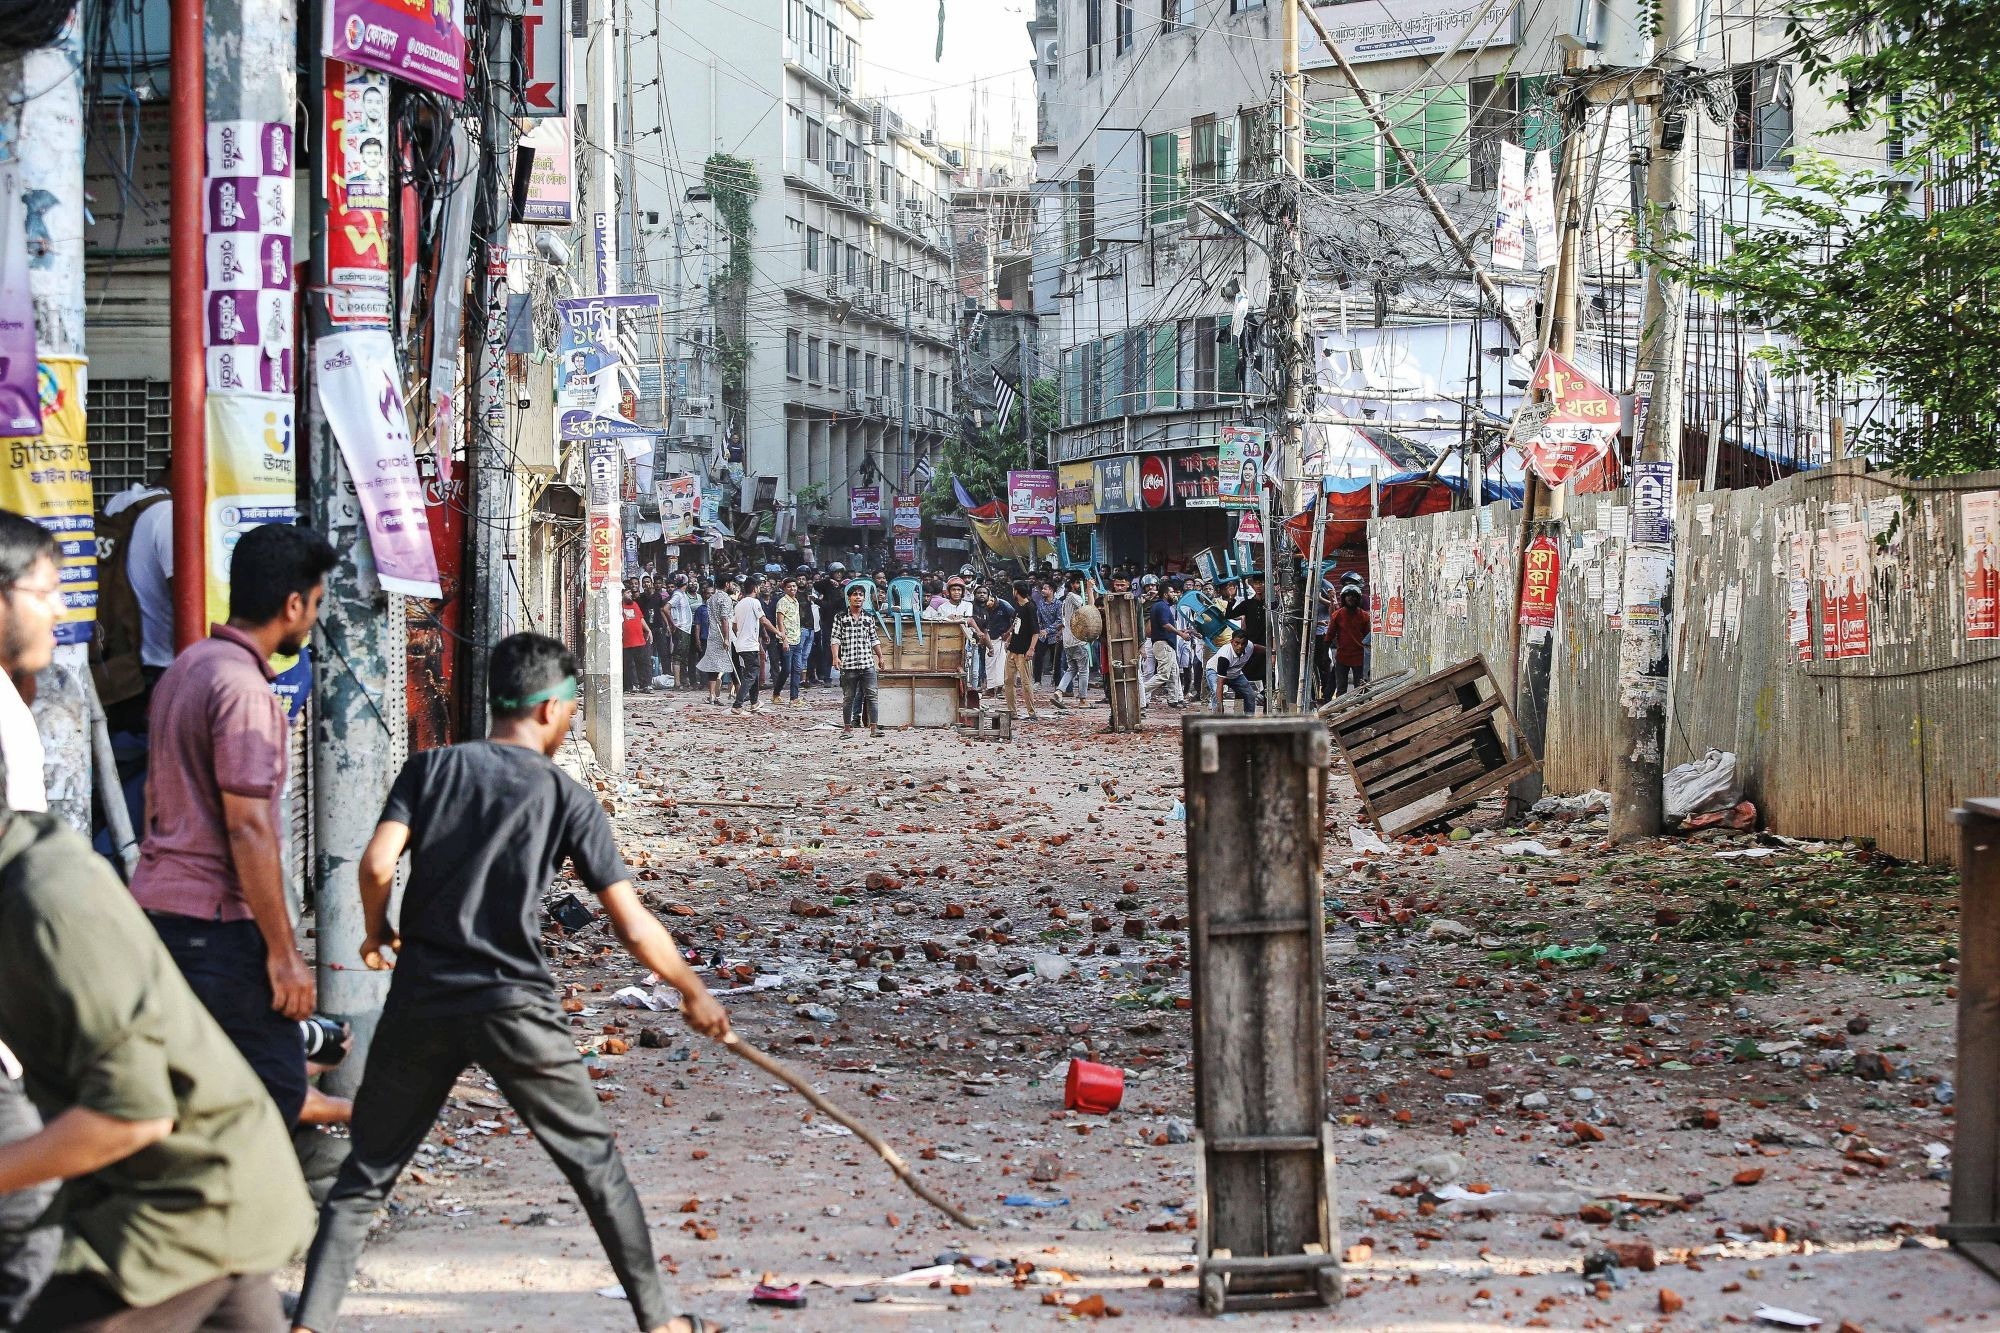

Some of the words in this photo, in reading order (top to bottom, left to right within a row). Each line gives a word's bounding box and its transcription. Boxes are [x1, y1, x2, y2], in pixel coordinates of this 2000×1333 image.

[1565, 400, 1608, 418] খবর
[11, 442, 74, 469] ট্রাফিক
[1527, 548, 1557, 602] ফোকাস
